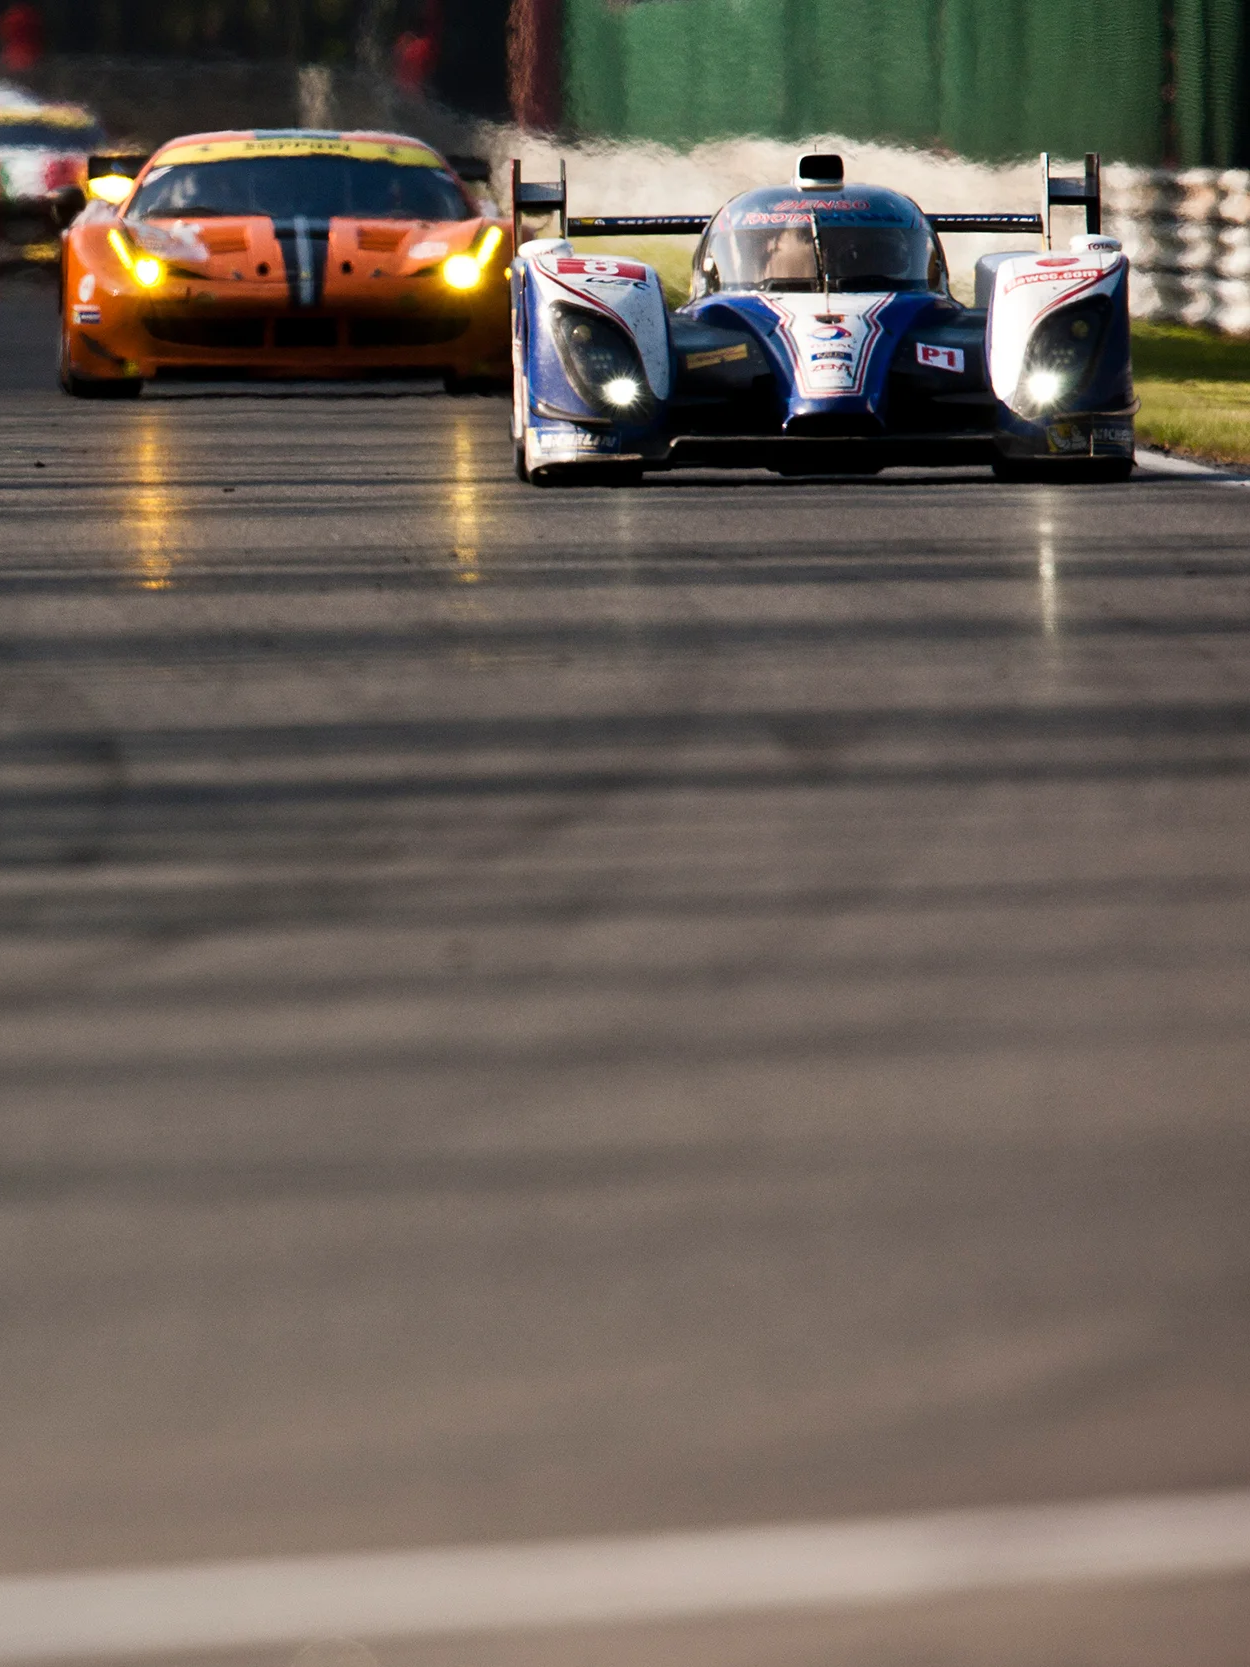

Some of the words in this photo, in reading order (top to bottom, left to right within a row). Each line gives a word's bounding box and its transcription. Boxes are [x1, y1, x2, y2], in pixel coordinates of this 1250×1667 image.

[773, 199, 871, 212] DENSO
[583, 260, 619, 276] 8
[921, 346, 957, 368] P1
